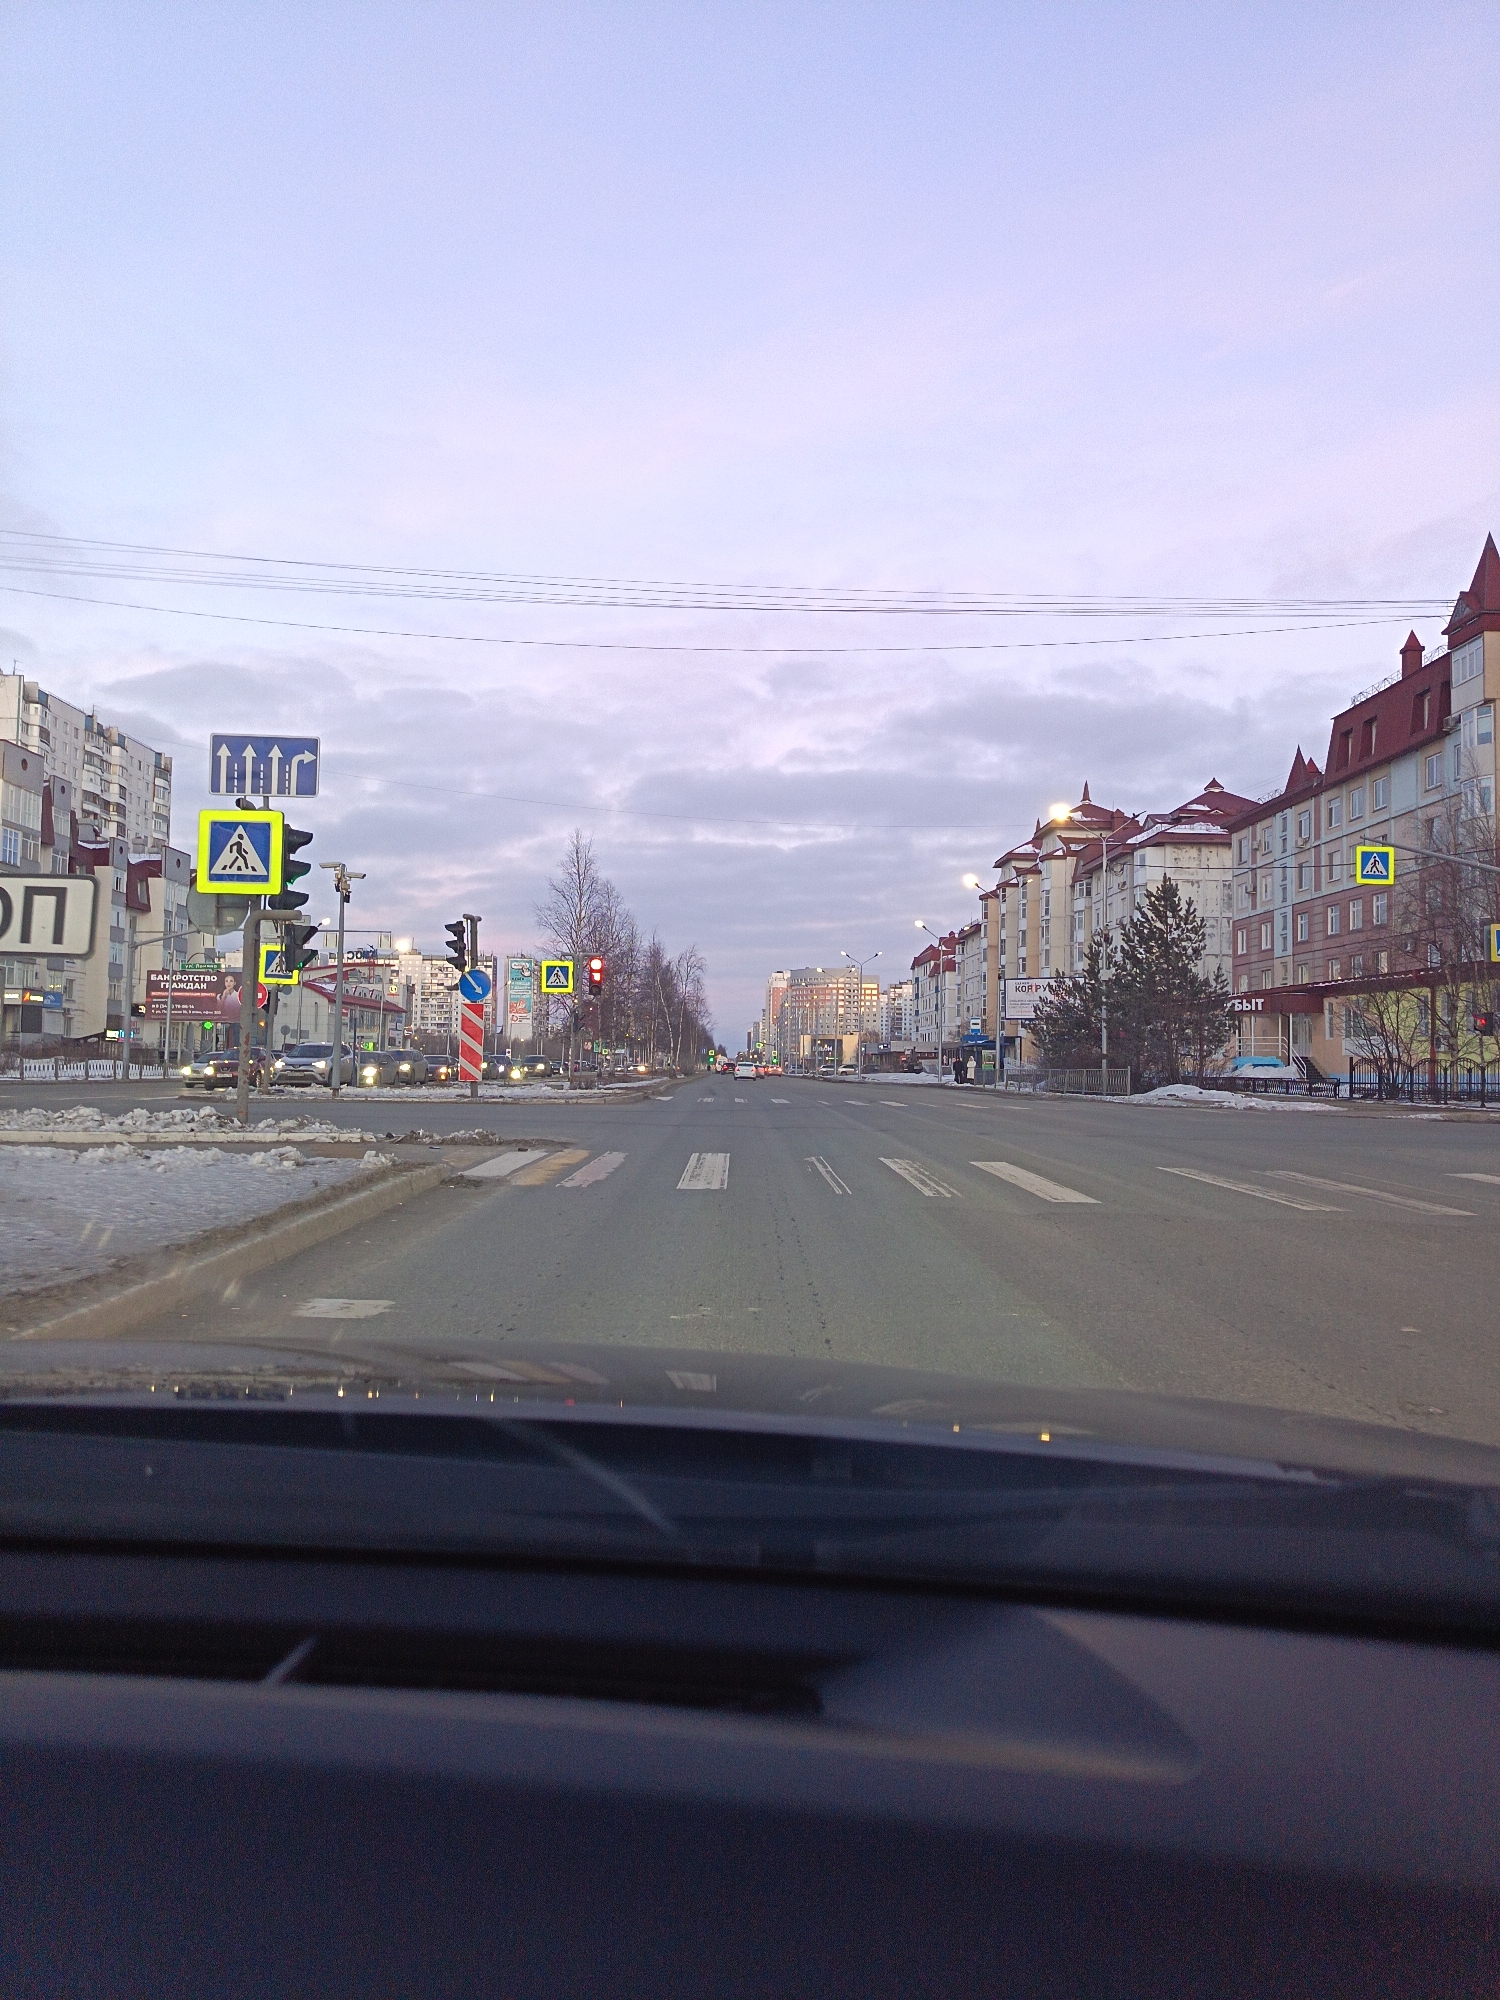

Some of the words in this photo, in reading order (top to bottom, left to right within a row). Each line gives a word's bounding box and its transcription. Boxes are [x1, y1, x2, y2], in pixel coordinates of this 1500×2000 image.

[0, 886, 67, 945] П
[150, 974, 218, 982] БАНКРОТСТВО
[160, 982, 207, 990] ГРАЖДАН
